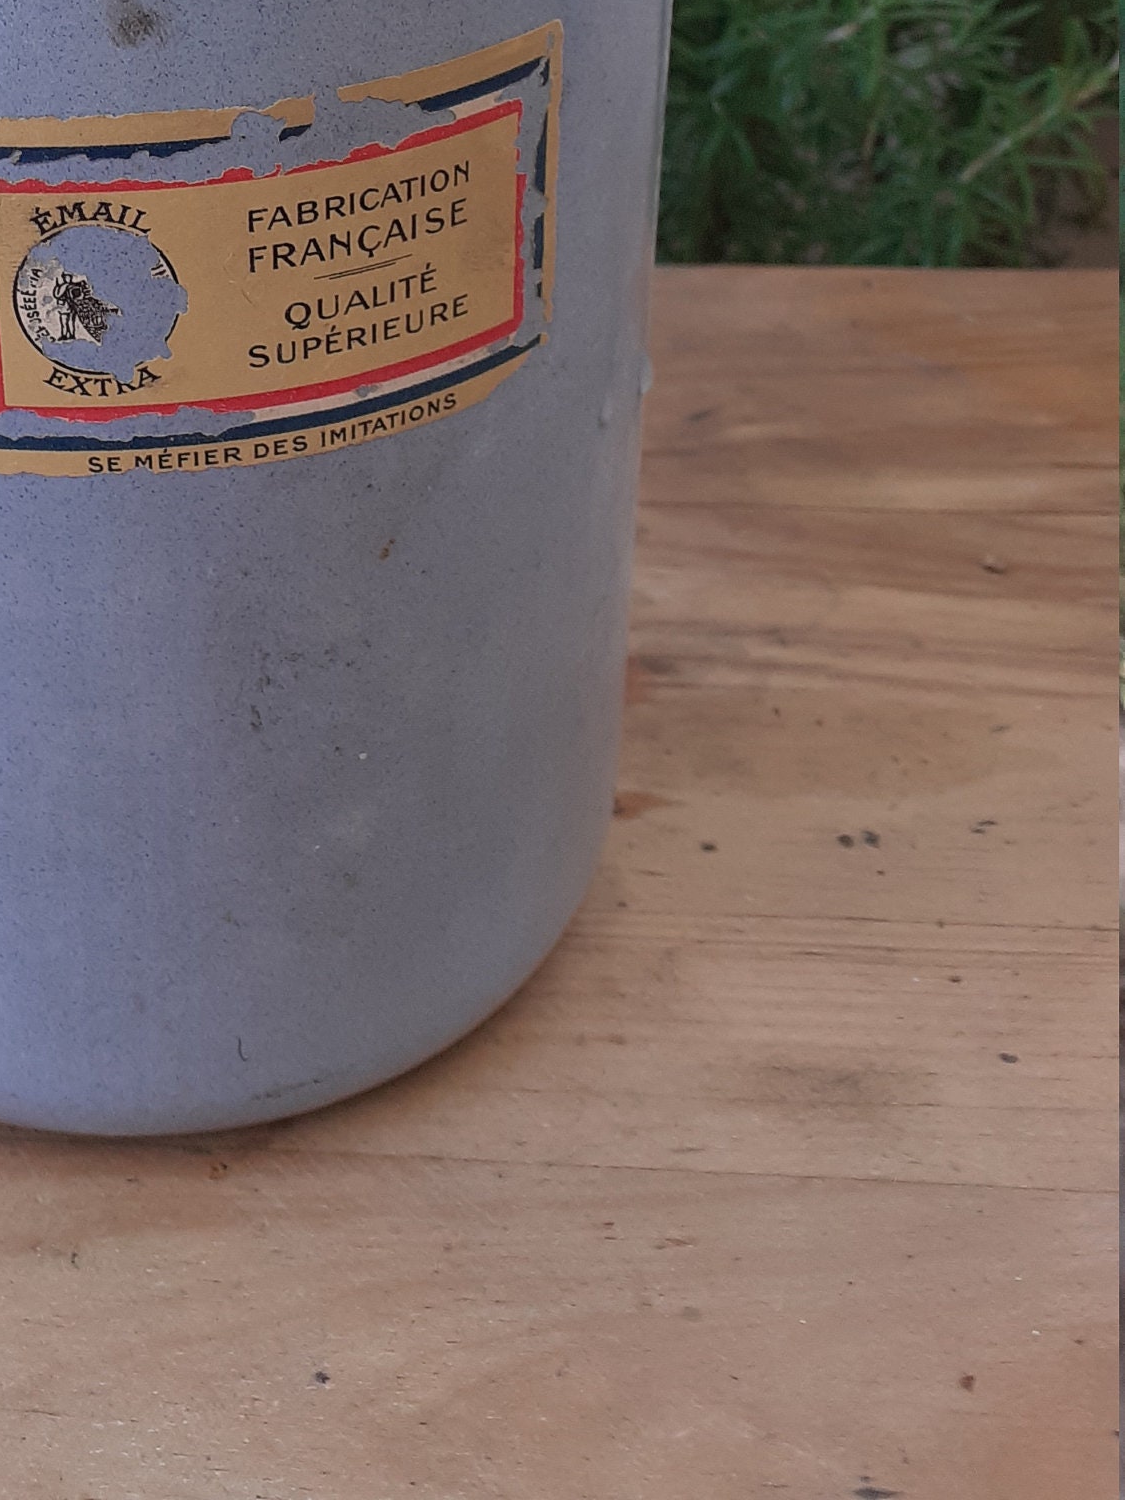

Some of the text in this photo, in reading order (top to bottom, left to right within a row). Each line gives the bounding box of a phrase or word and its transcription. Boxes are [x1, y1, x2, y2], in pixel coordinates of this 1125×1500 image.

[30, 201, 152, 237] ÉMAIL
[248, 160, 470, 233] FABRICATION
[248, 197, 468, 274] FRANÇAISE
[248, 293, 469, 368] SUPÉRIEURE
[284, 262, 438, 331] QUALITÉ
[88, 392, 457, 474] SE MÉFIER DES IMITATIONS
